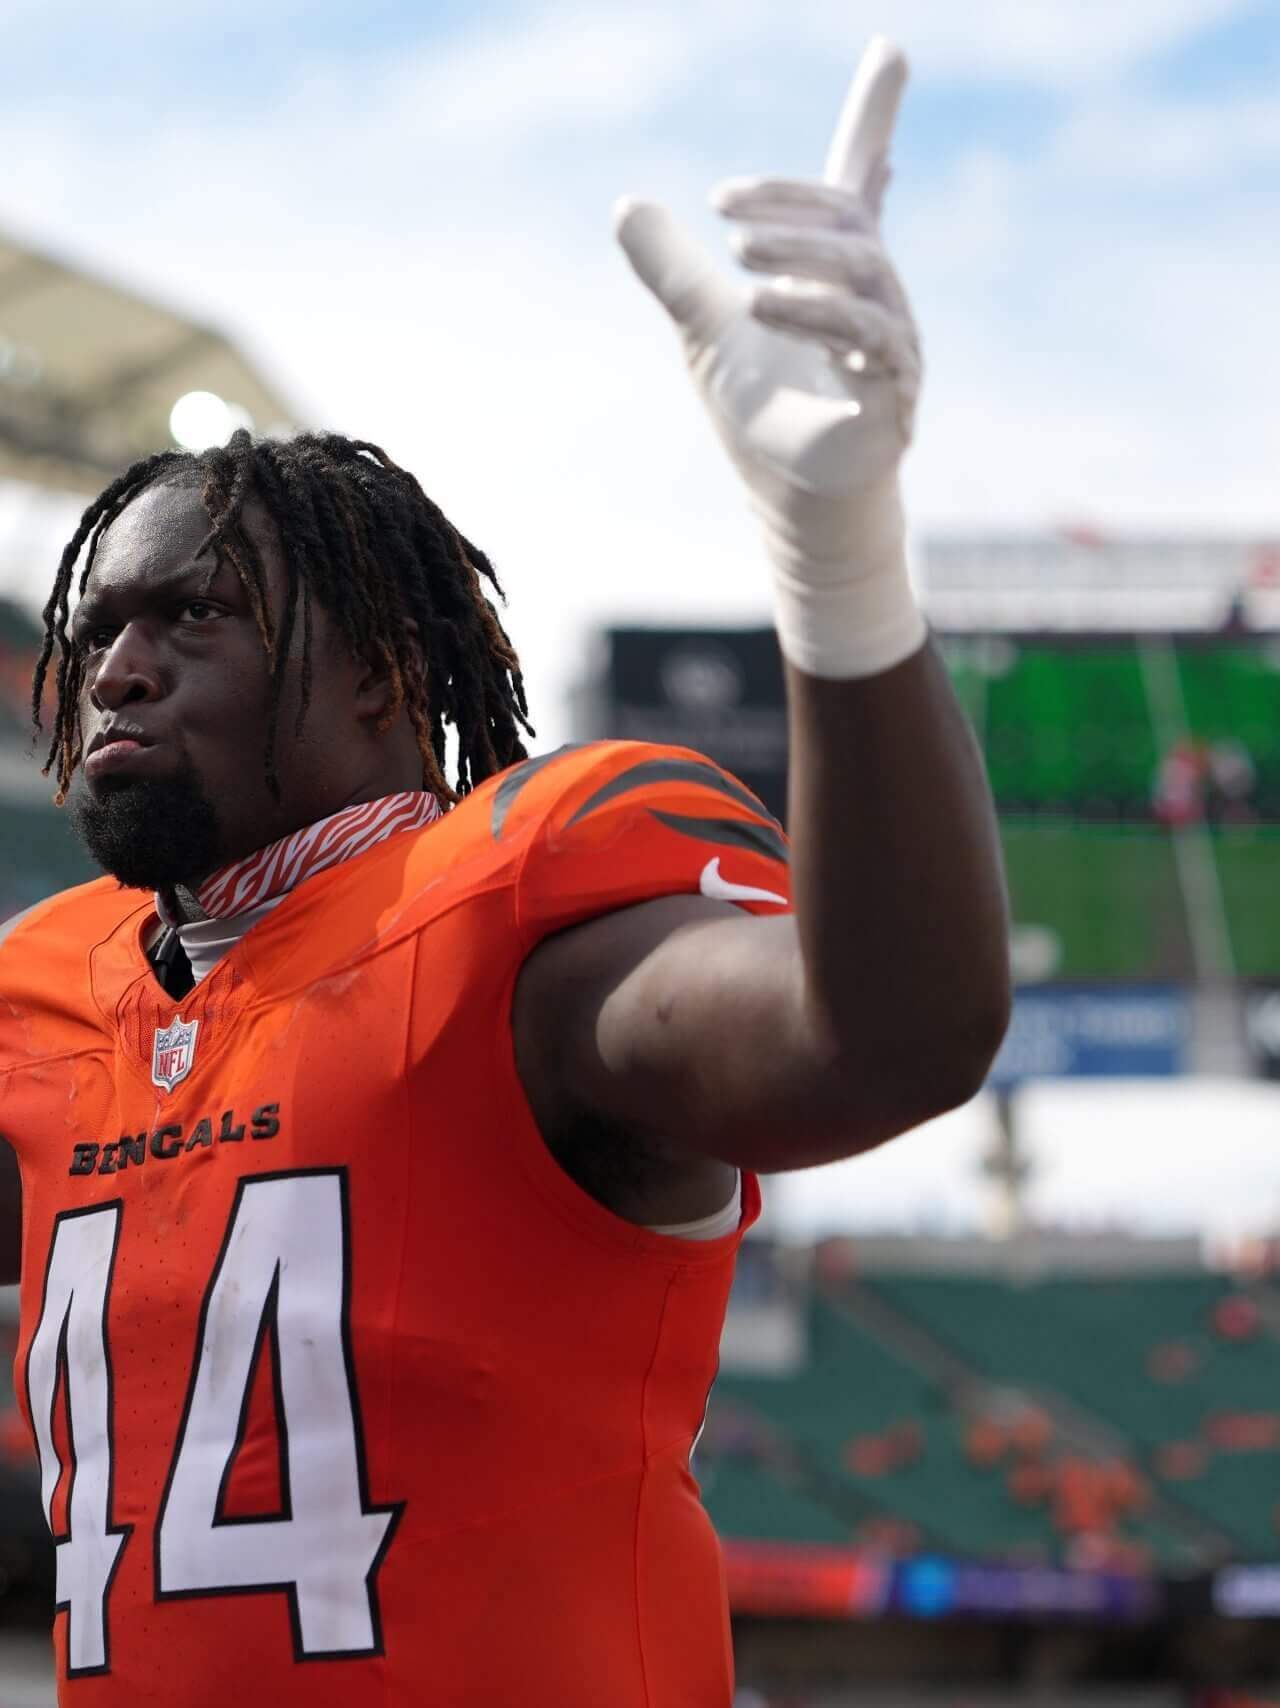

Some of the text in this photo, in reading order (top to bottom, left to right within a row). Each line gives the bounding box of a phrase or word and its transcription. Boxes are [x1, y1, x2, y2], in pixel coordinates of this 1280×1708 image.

[158, 1048, 185, 1078] NFL
[69, 1103, 280, 1176] BENGALS
[25, 1165, 407, 1680] 44
